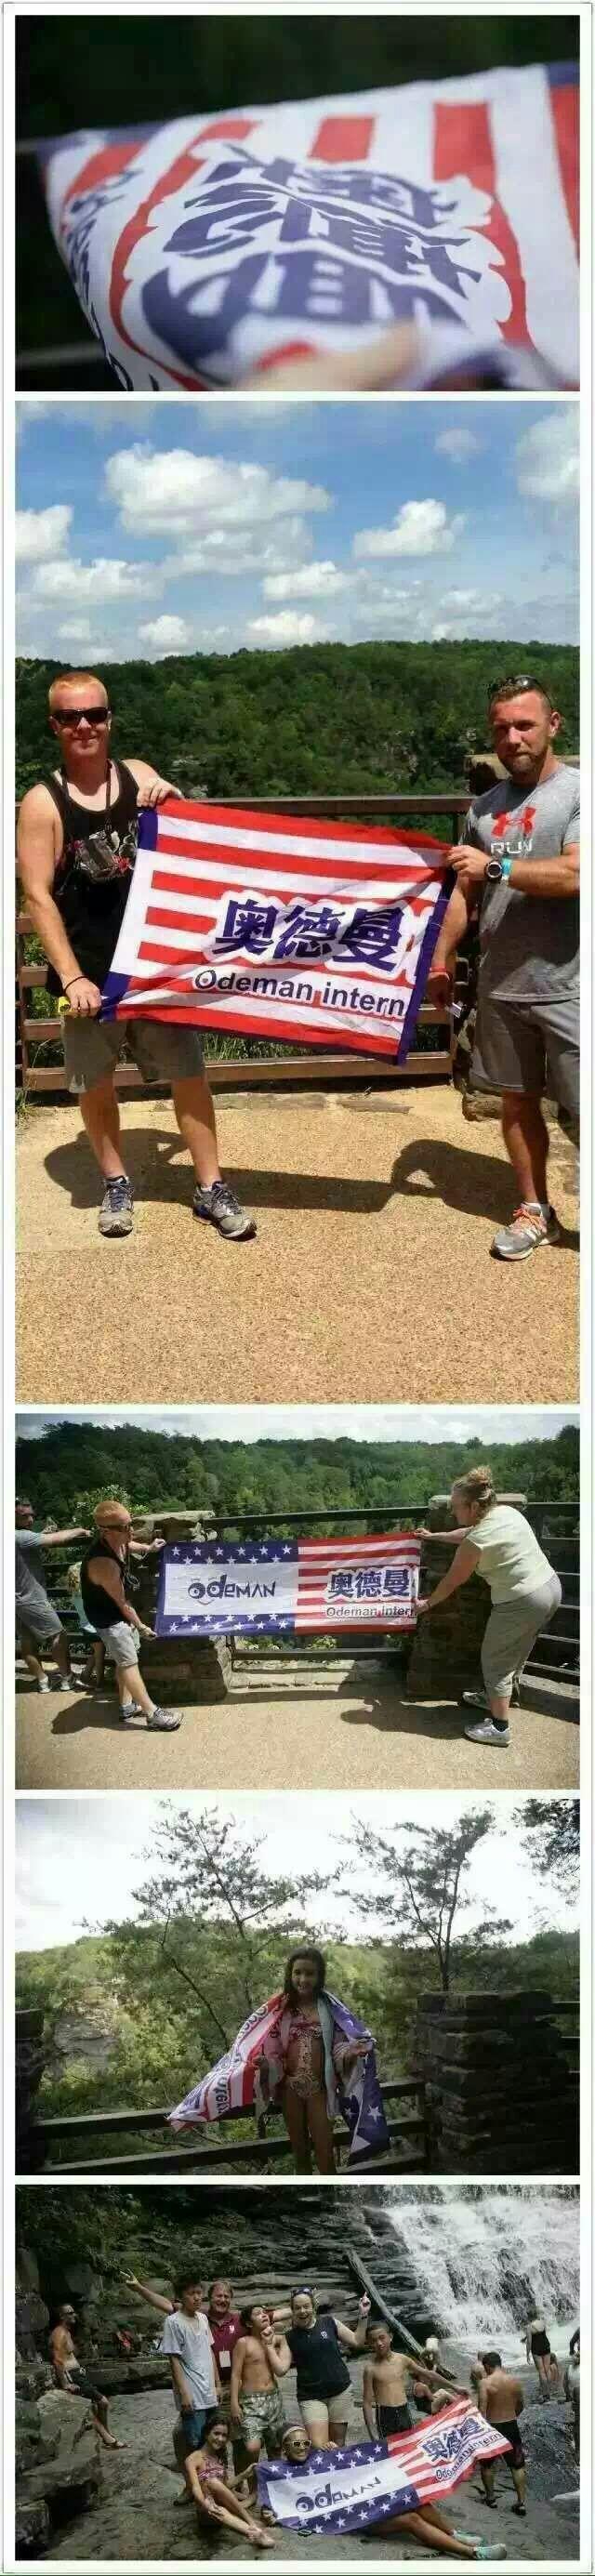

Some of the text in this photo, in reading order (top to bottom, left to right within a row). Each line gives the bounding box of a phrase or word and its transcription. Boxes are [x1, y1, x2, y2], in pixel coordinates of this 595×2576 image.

[491, 839, 533, 853] RUN
[212, 899, 404, 971] 奥德曼
[194, 970, 405, 1017] Odeman intern
[328, 1569, 410, 1599] 奥德曼
[326, 1606, 377, 1617] Odeman
